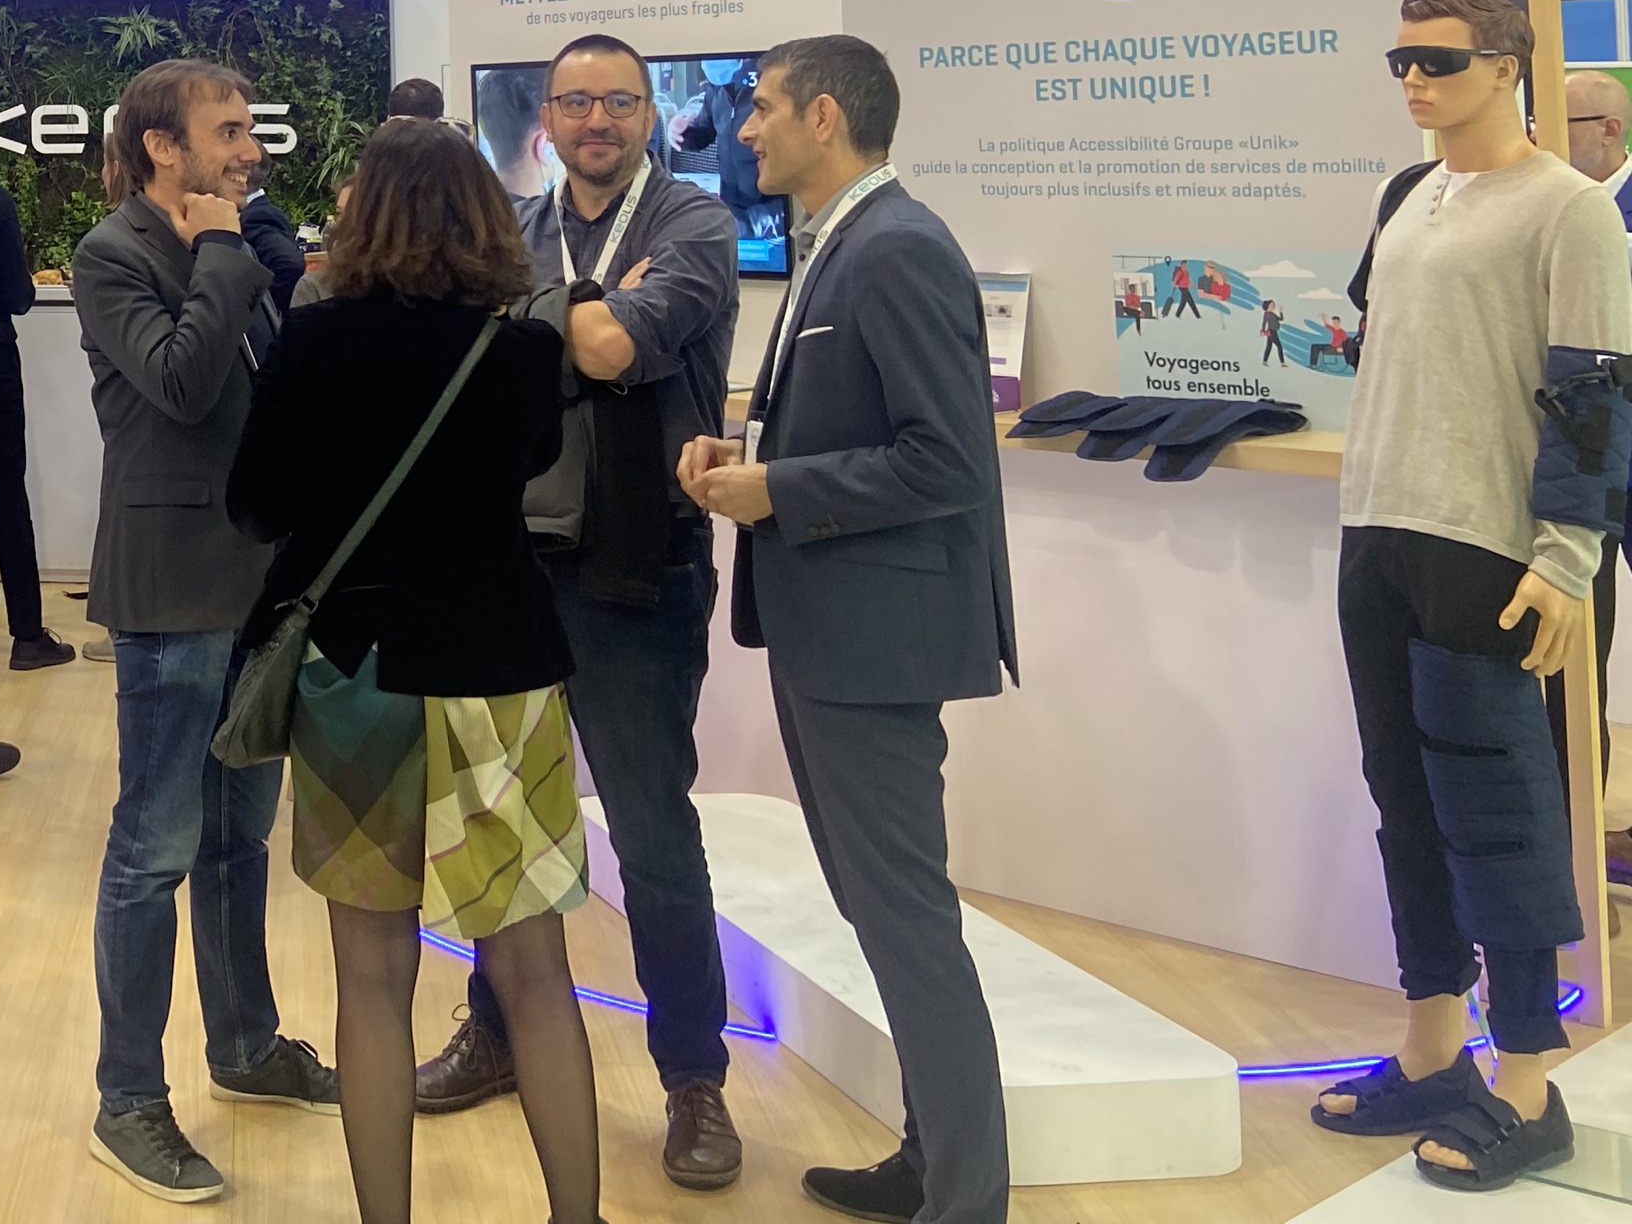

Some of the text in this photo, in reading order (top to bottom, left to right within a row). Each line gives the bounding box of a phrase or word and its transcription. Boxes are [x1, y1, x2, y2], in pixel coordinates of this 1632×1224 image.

[526, 0, 744, 25] de nos voyageurs les plus fragiles
[919, 29, 1339, 70] PARCE QUE CHAQUE VOYAGEUR
[747, 71, 758, 88] 3
[1035, 74, 1210, 104] EST UNIQUE !
[978, 135, 1299, 155] La politique Accessibilité Groupe «Unik»
[912, 158, 1386, 177] guide la conception et la promotion de services de mobilité
[981, 182, 1306, 201] toujours plus inclusifs et mieux adaptés.
[1144, 351, 1241, 374] Voyageons
[1146, 376, 1271, 398] tous ensemble
